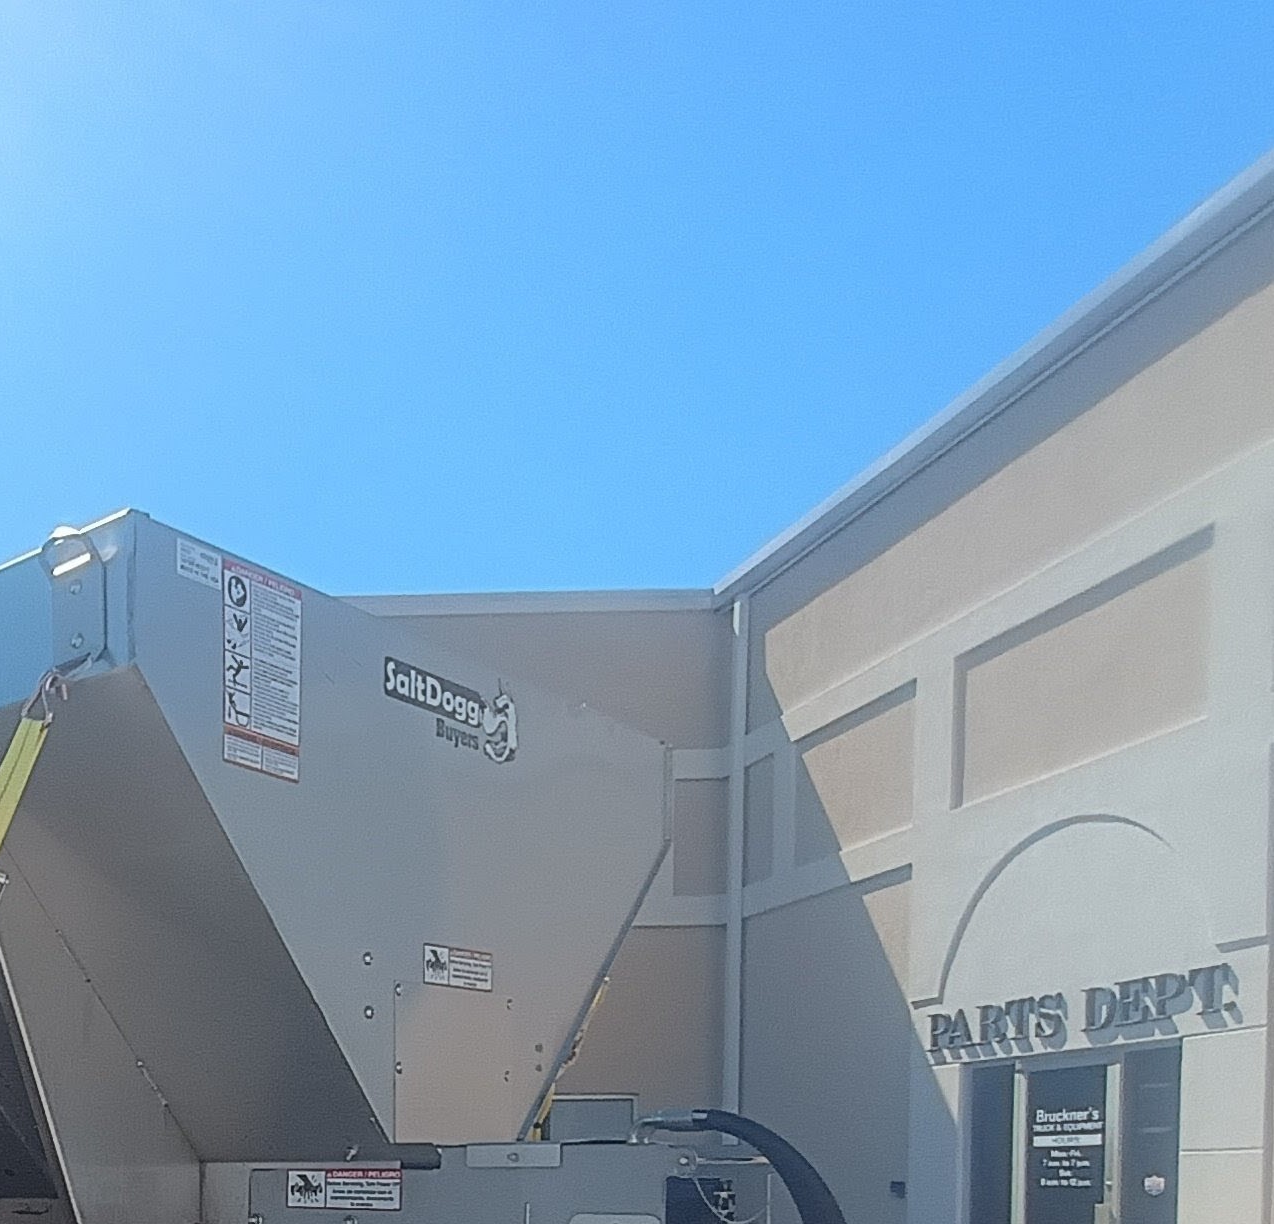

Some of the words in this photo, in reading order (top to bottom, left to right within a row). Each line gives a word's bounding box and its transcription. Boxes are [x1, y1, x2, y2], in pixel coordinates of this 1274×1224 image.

[386, 661, 480, 726] SaltDogg
[436, 717, 479, 751] Buyers
[926, 991, 1067, 1052] PARTS
[1035, 1106, 1100, 1123] Bruckner's
